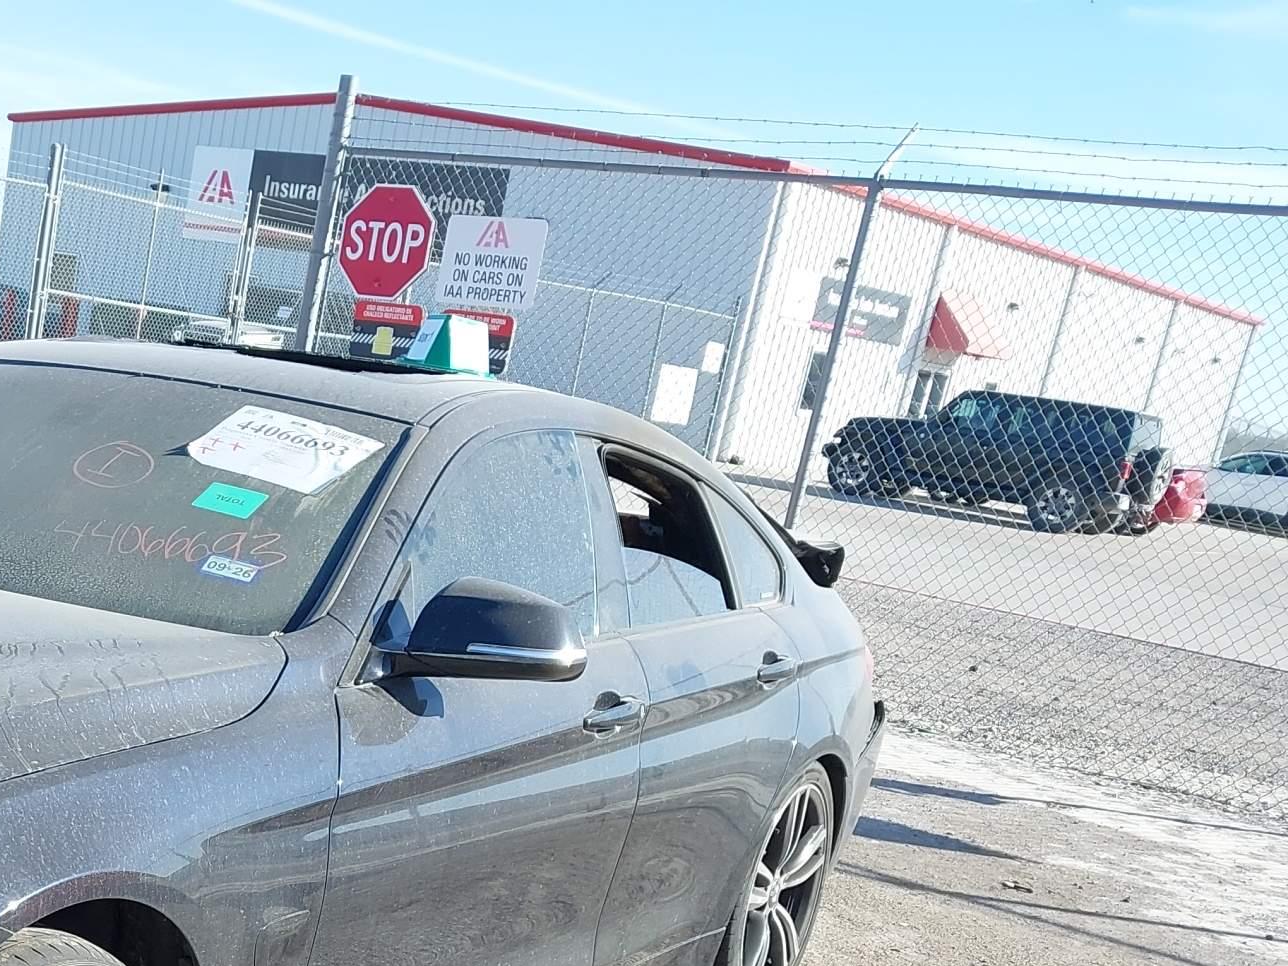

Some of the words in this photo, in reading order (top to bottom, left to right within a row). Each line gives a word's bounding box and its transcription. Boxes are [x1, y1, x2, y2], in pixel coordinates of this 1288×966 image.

[345, 219, 425, 264] STOP
[454, 252, 471, 266] NO
[474, 253, 528, 271] WORKING
[452, 268, 469, 282] ON
[472, 270, 503, 286] CARS
[506, 273, 524, 288] ON
[443, 284, 463, 299] IAA
[466, 286, 527, 304] PROPERTY
[236, 420, 350, 457] 44066693
[54, 519, 288, 570] 44066693
